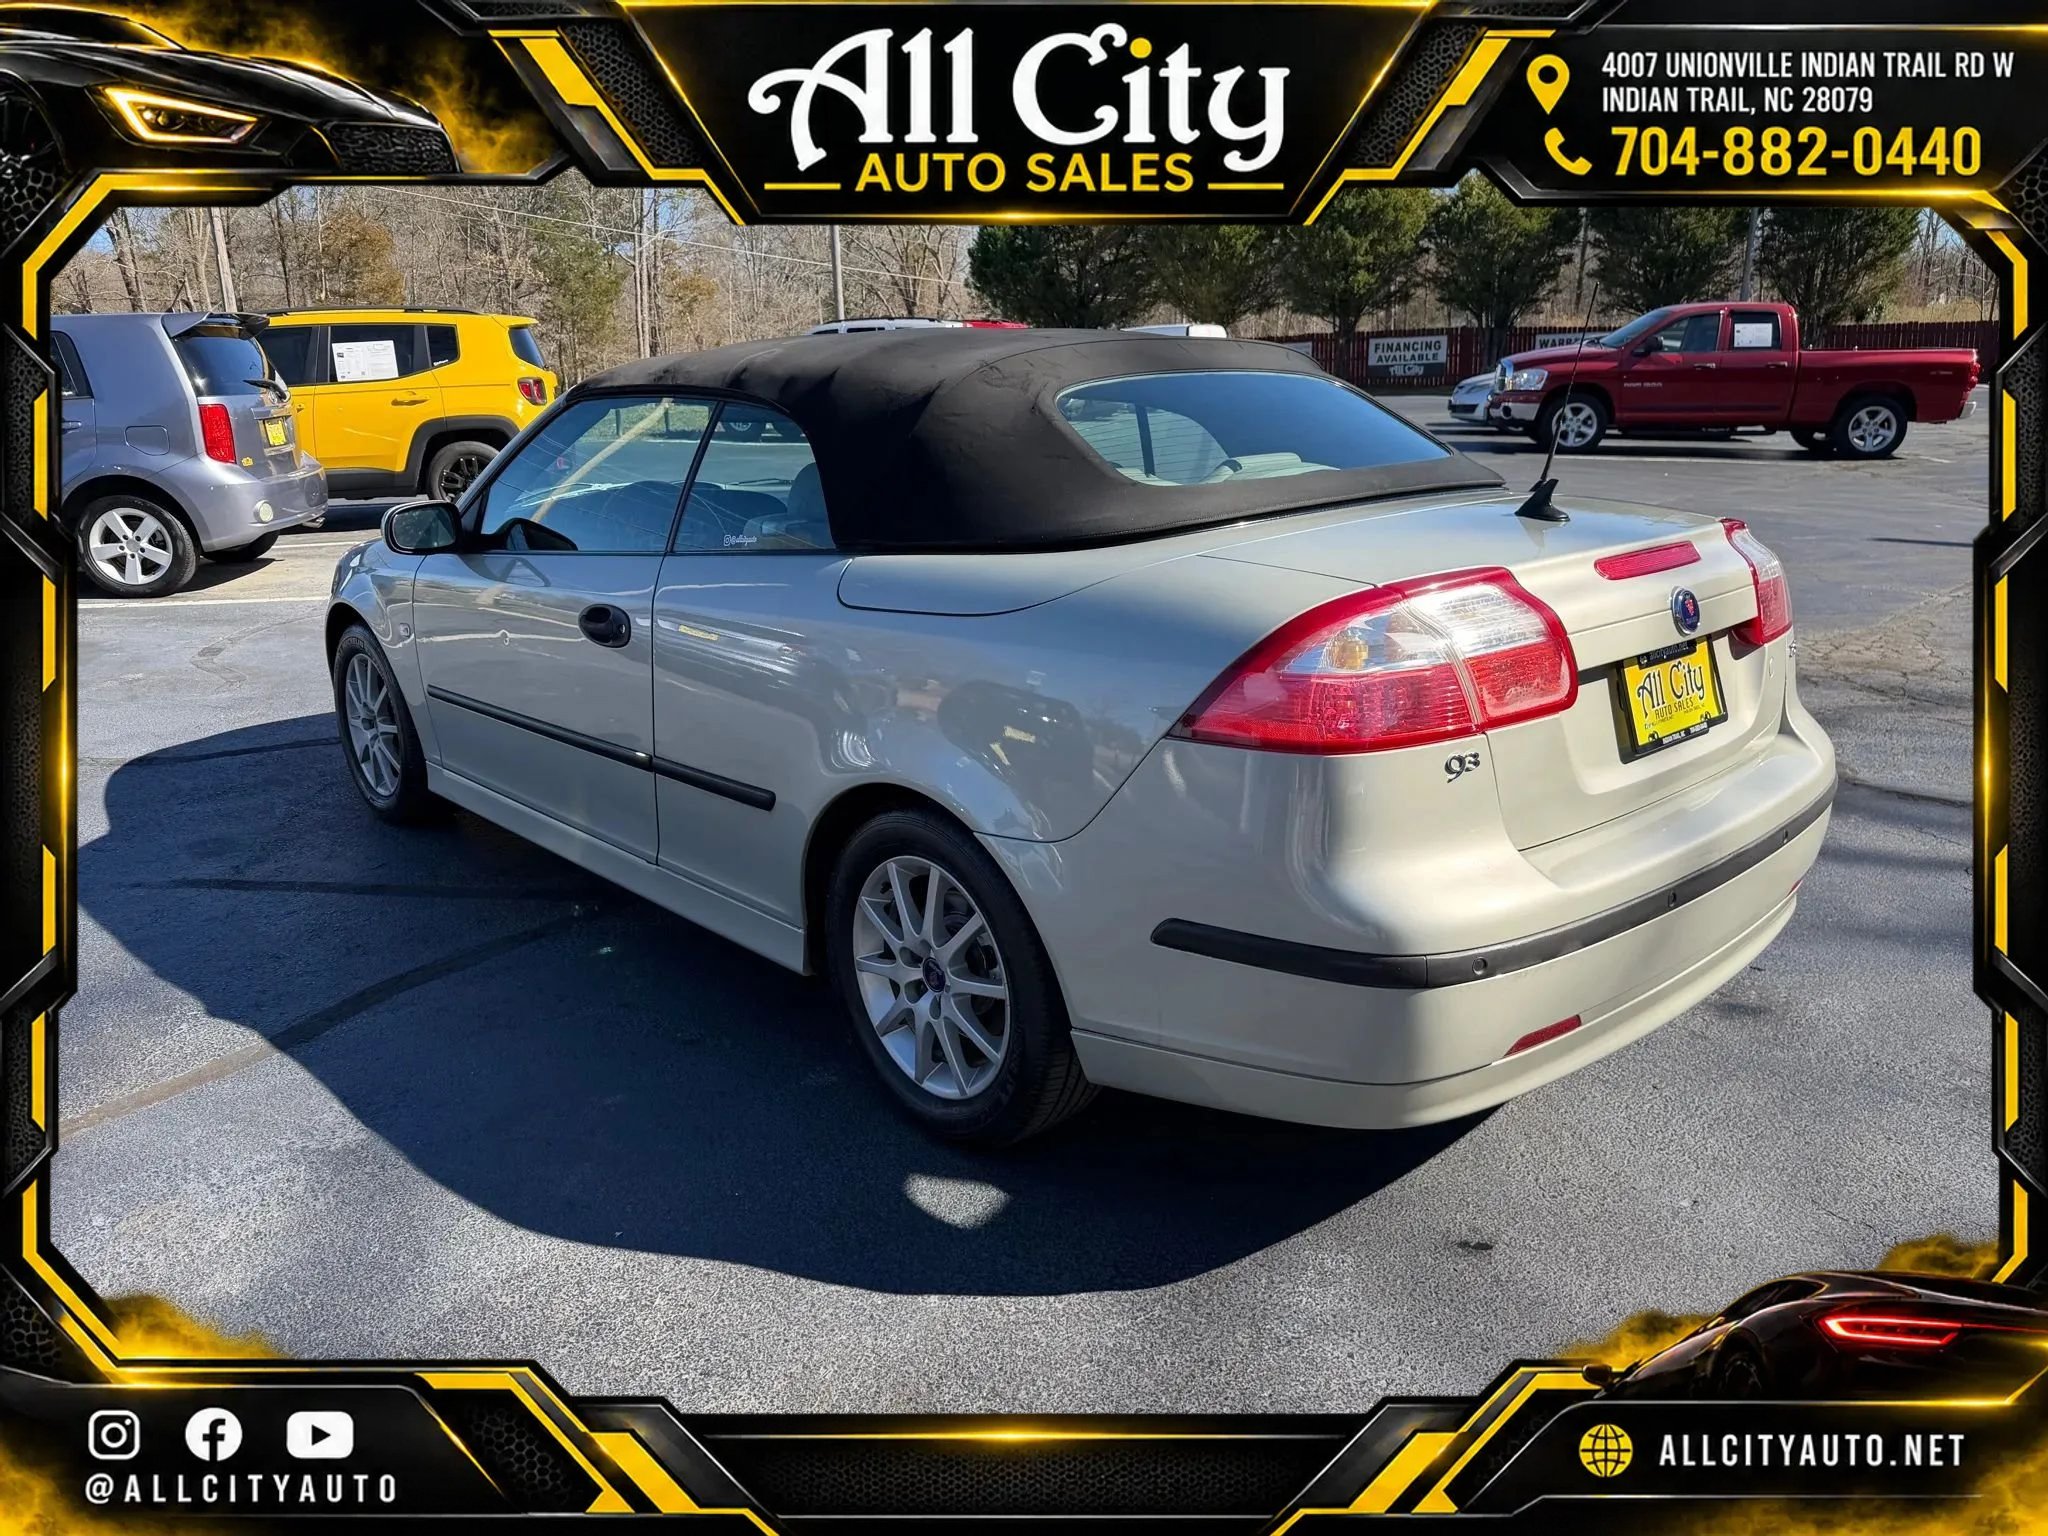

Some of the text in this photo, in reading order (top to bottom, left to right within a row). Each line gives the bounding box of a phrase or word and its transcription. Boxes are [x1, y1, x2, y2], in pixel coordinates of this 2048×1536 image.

[1374, 340, 1441, 353] FINANCING
[1376, 352, 1439, 363] AVAILABLE
[1637, 660, 1705, 719] All City
[1655, 704, 1672, 719] AUTO
[1674, 697, 1694, 713] SALES
